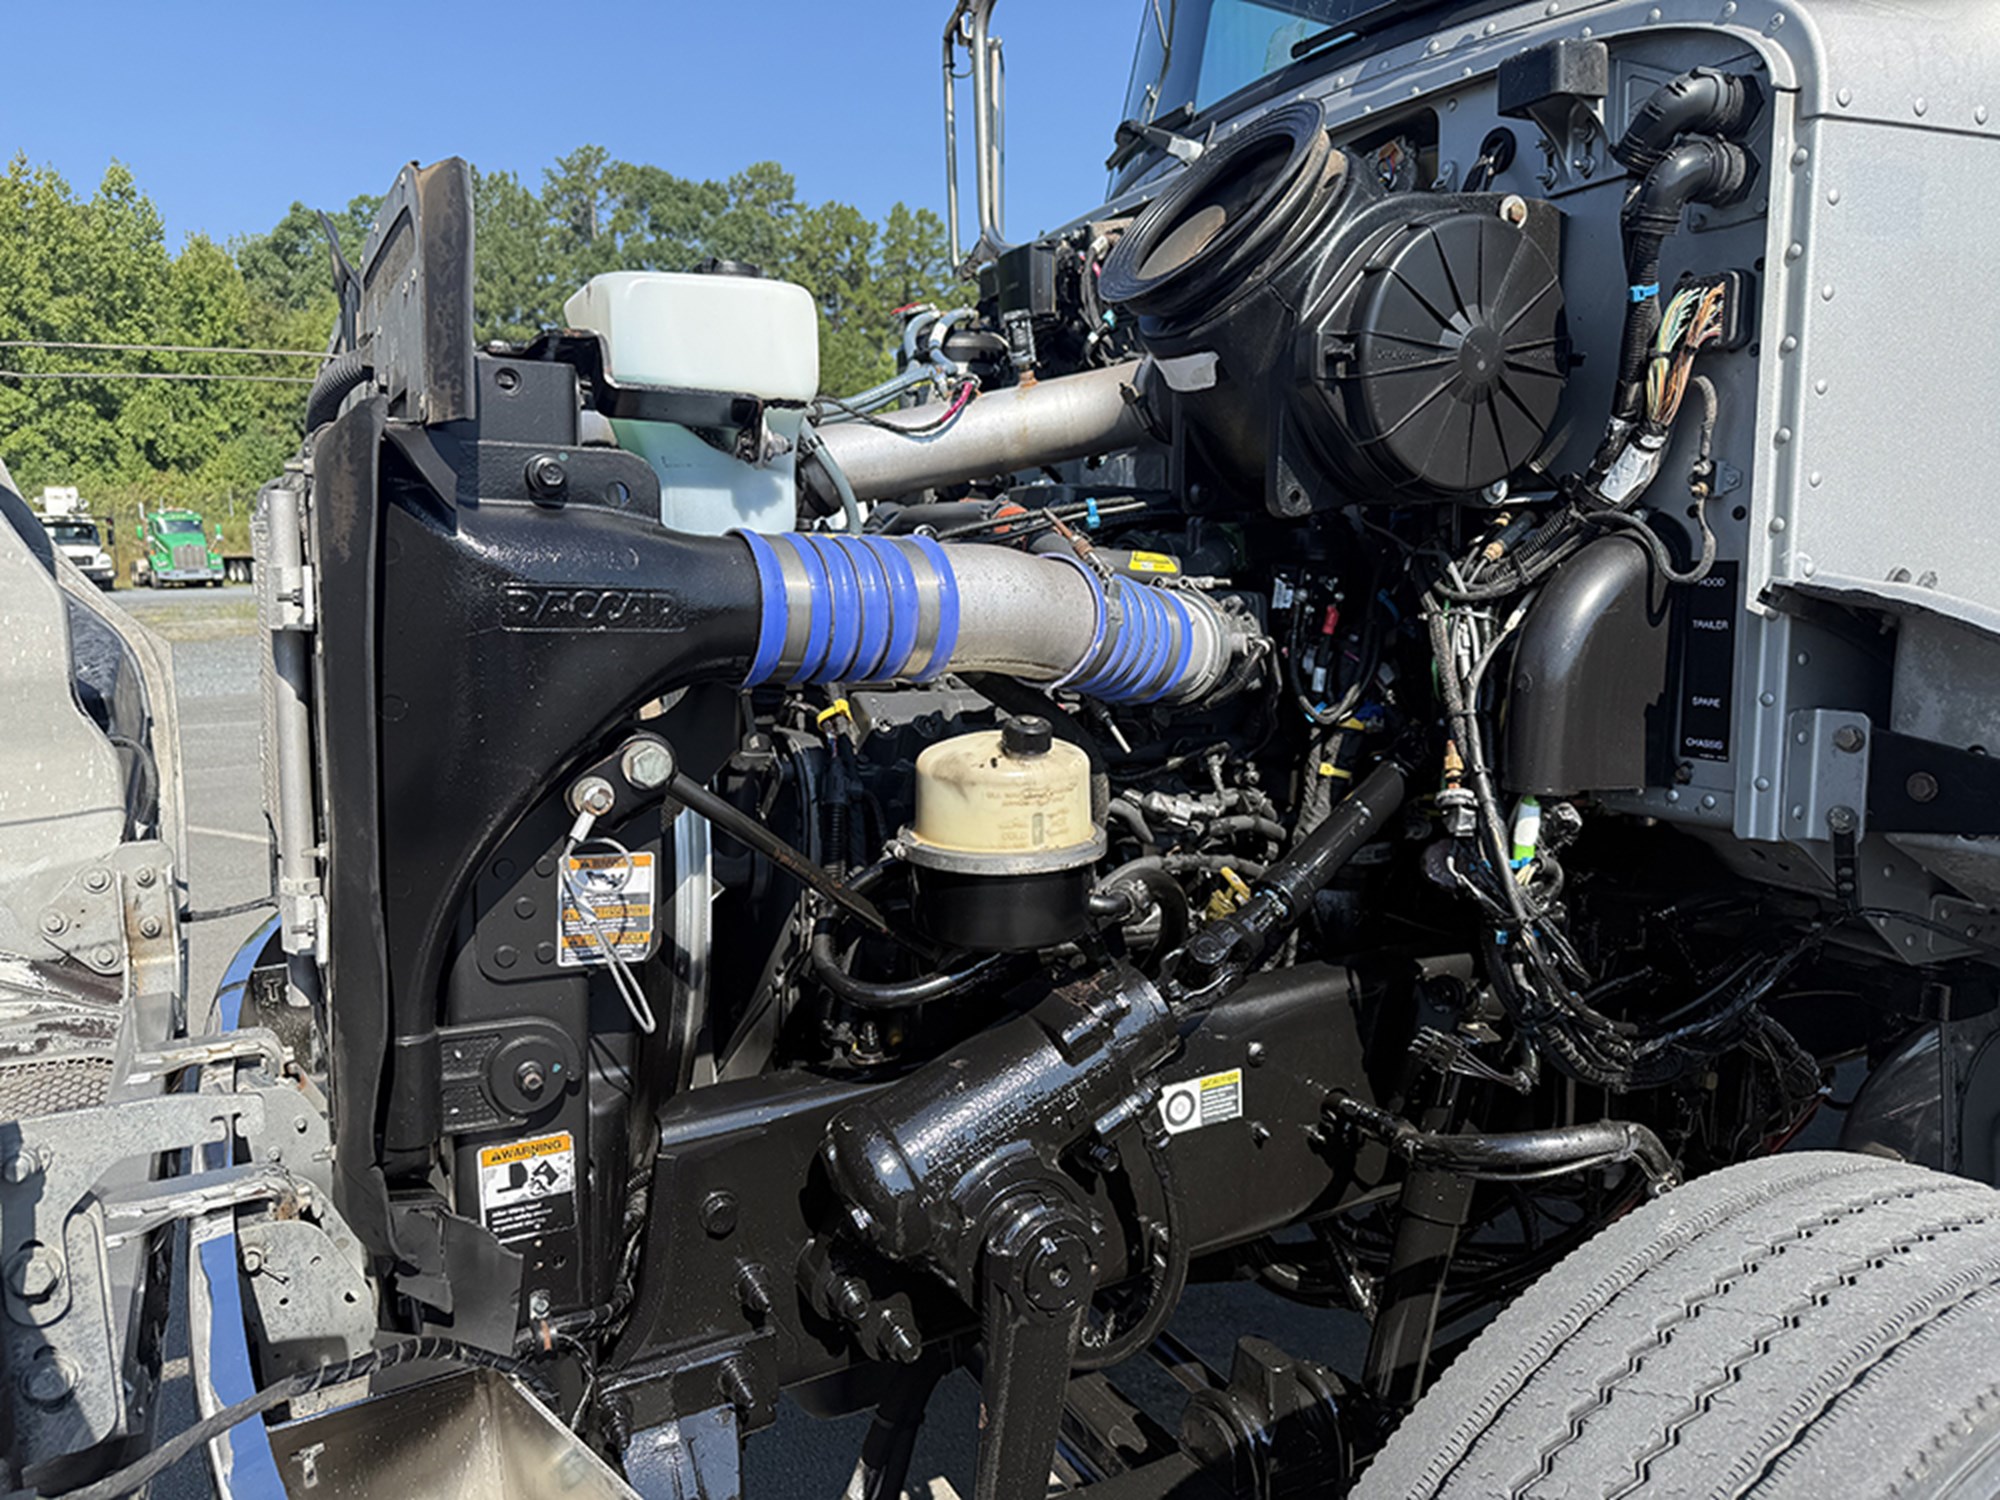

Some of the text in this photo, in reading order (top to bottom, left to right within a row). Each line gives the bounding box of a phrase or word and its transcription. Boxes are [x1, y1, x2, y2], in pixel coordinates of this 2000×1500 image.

[506, 589, 680, 622] PACCAR
[1693, 619, 1729, 630] TRAILER
[1692, 696, 1721, 708] SPARE
[1685, 737, 1724, 750] CHASSIS
[501, 1140, 562, 1159] WARNING
